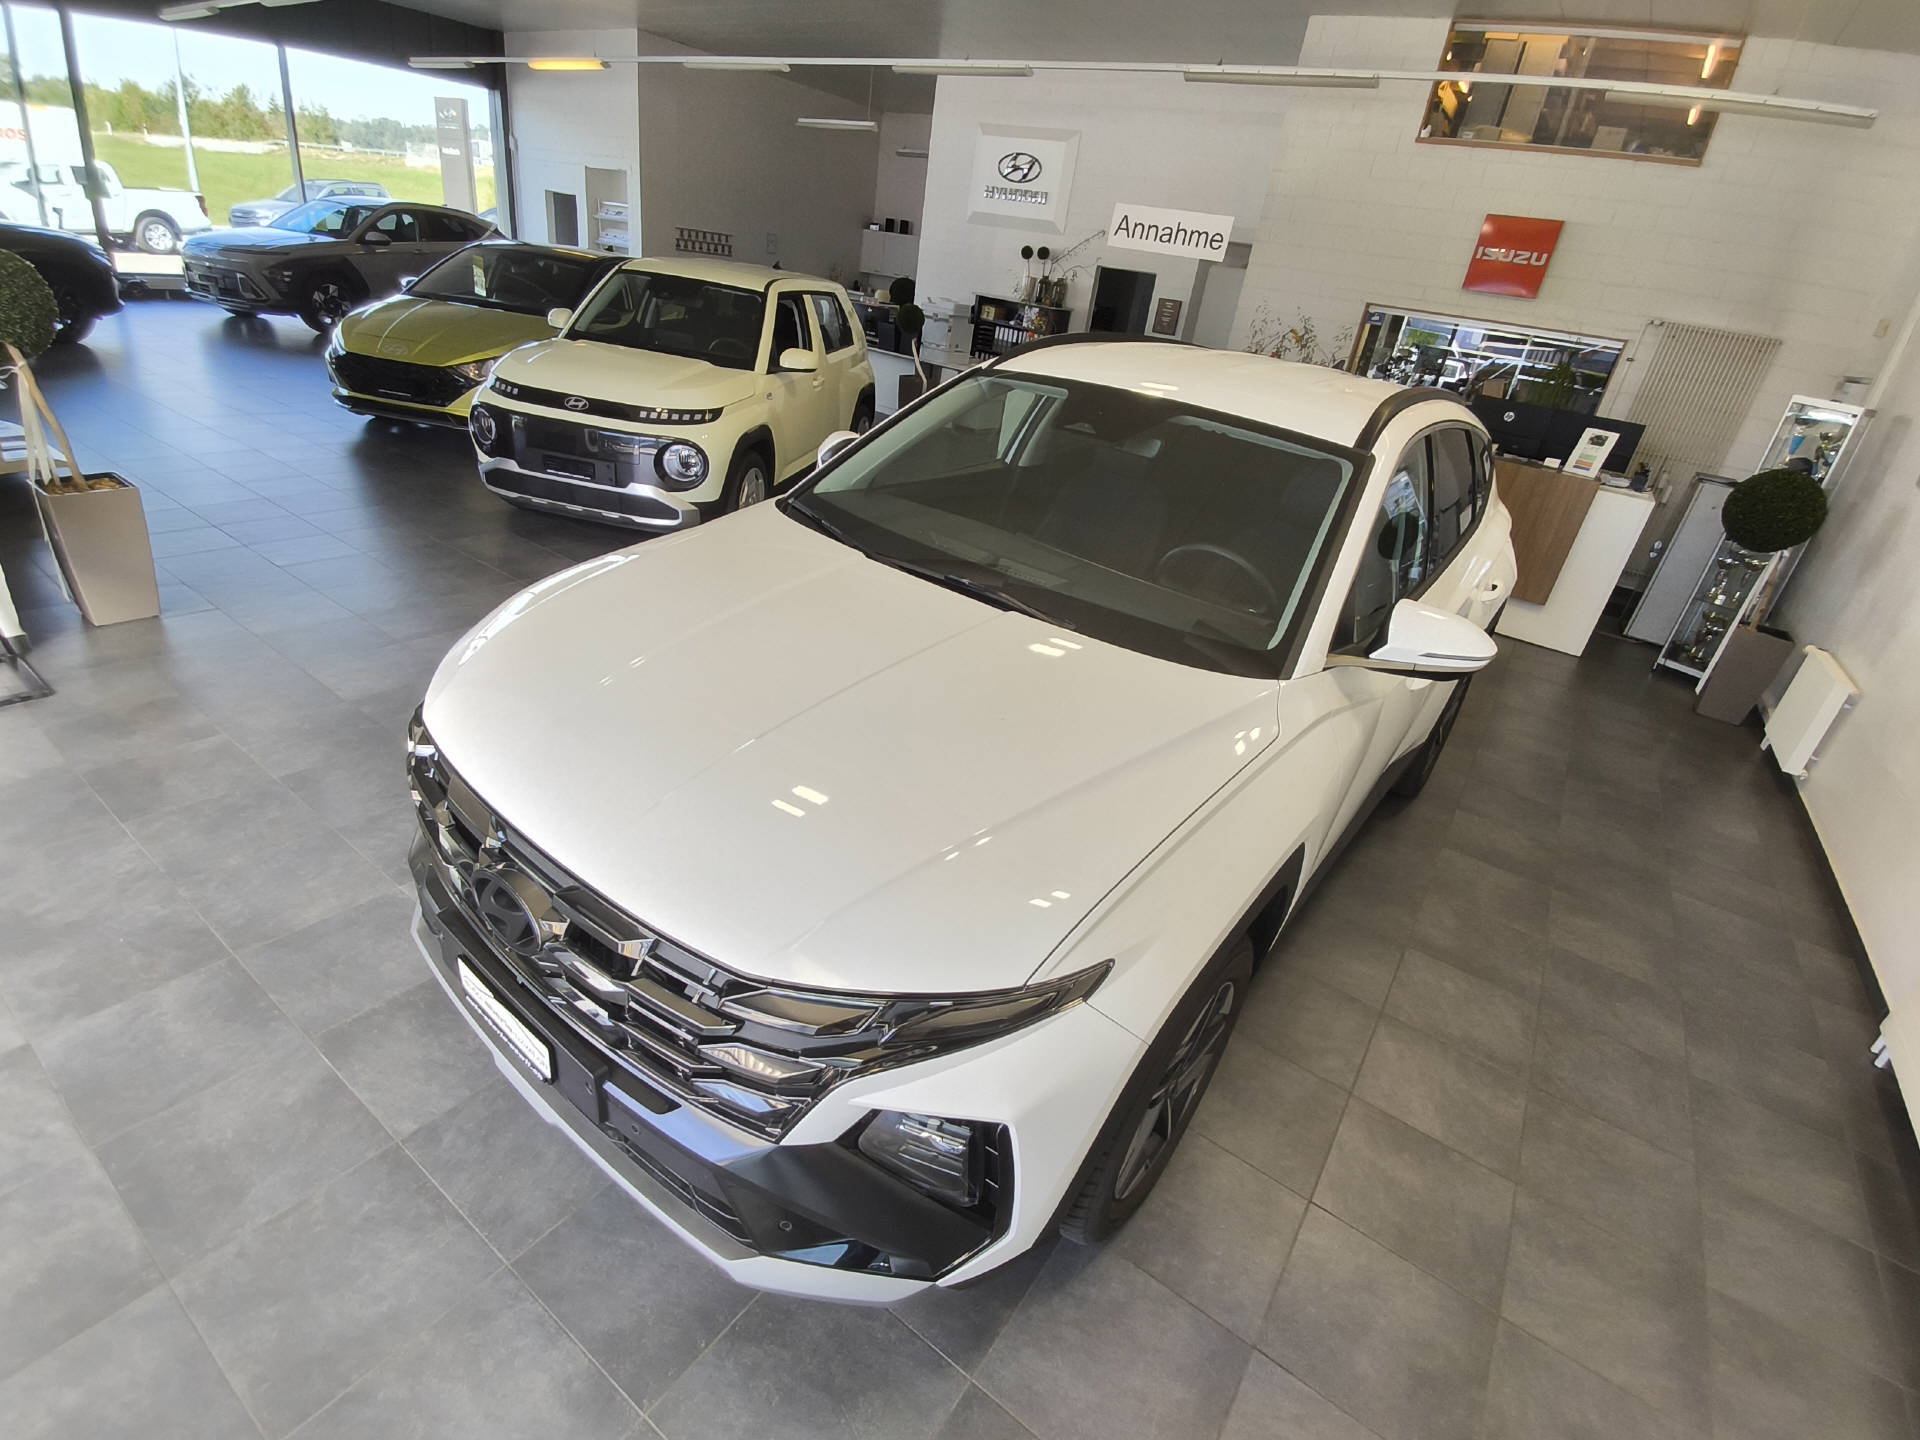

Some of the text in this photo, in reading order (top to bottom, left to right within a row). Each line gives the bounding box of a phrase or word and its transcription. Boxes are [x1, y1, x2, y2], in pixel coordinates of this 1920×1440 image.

[984, 185, 1048, 205] HYUNDAI
[1114, 214, 1224, 250] Annahme
[1476, 246, 1548, 266] ISUZU
